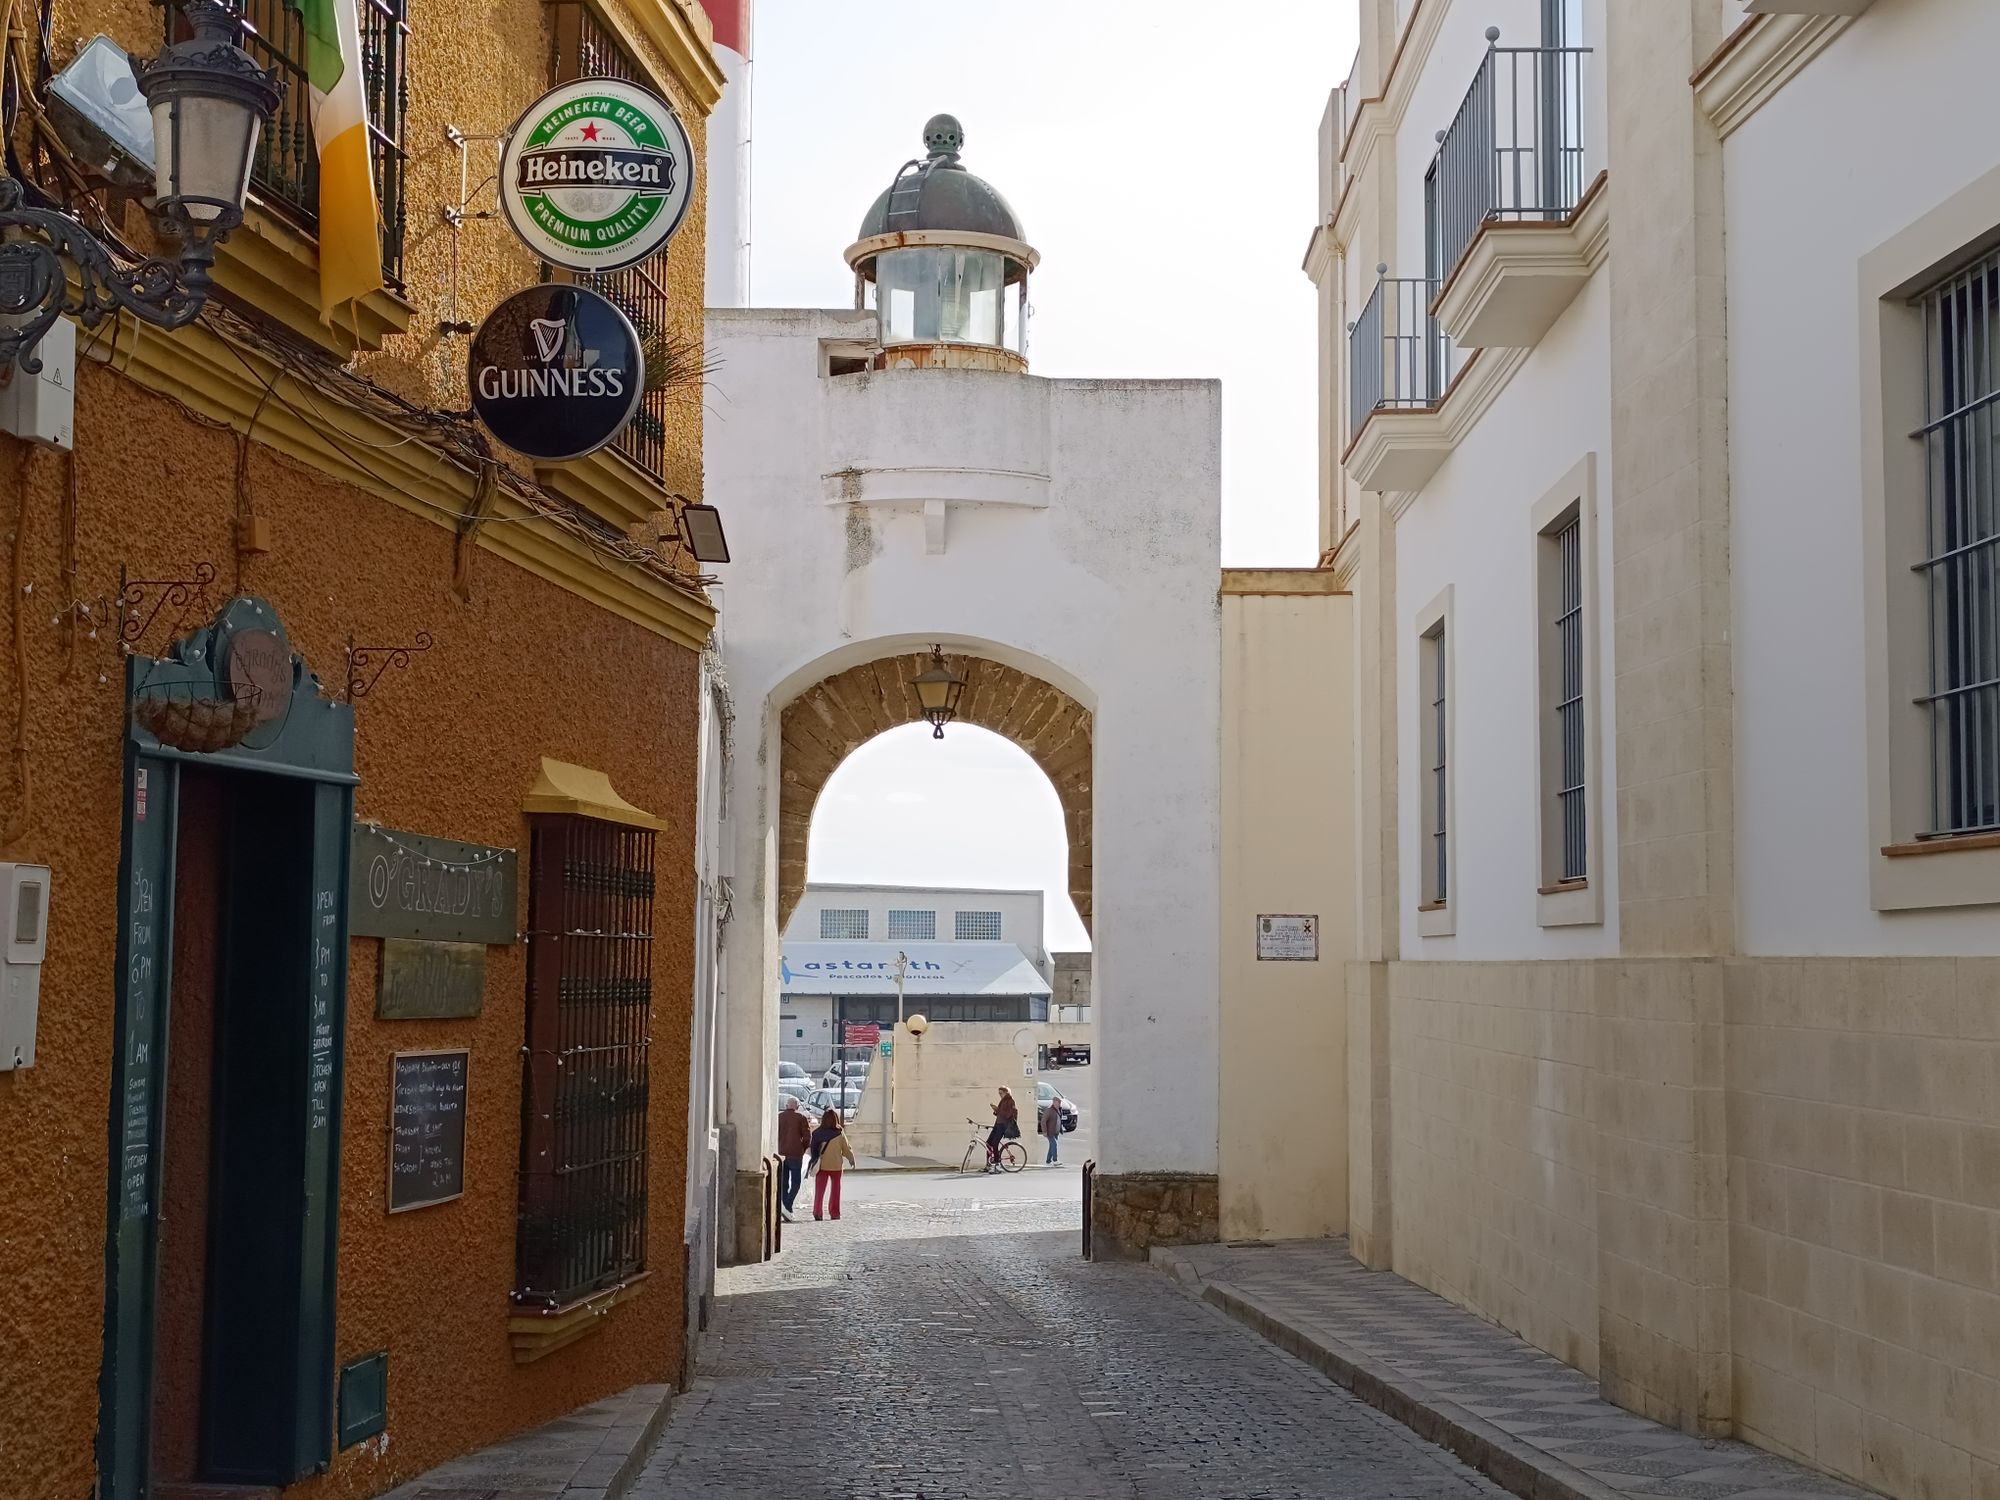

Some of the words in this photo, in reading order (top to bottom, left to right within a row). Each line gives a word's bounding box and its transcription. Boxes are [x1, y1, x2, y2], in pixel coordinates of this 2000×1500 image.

[542, 101, 611, 134] HEINEKEN
[614, 106, 647, 134] BEER
[534, 202, 590, 242] PREMIUM
[596, 202, 649, 241] QUALITY
[478, 365, 624, 400] GUINNESS
[368, 851, 503, 919] O'GRADY'S
[322, 913, 336, 928] FROM
[133, 922, 151, 945] FROM
[803, 959, 941, 971] astarth
[320, 973, 328, 987] TO
[133, 990, 145, 1021] TO
[312, 1062, 333, 1078] ITCHEN
[314, 1080, 327, 1092] OPEN
[127, 1173, 145, 1191] OPEN
